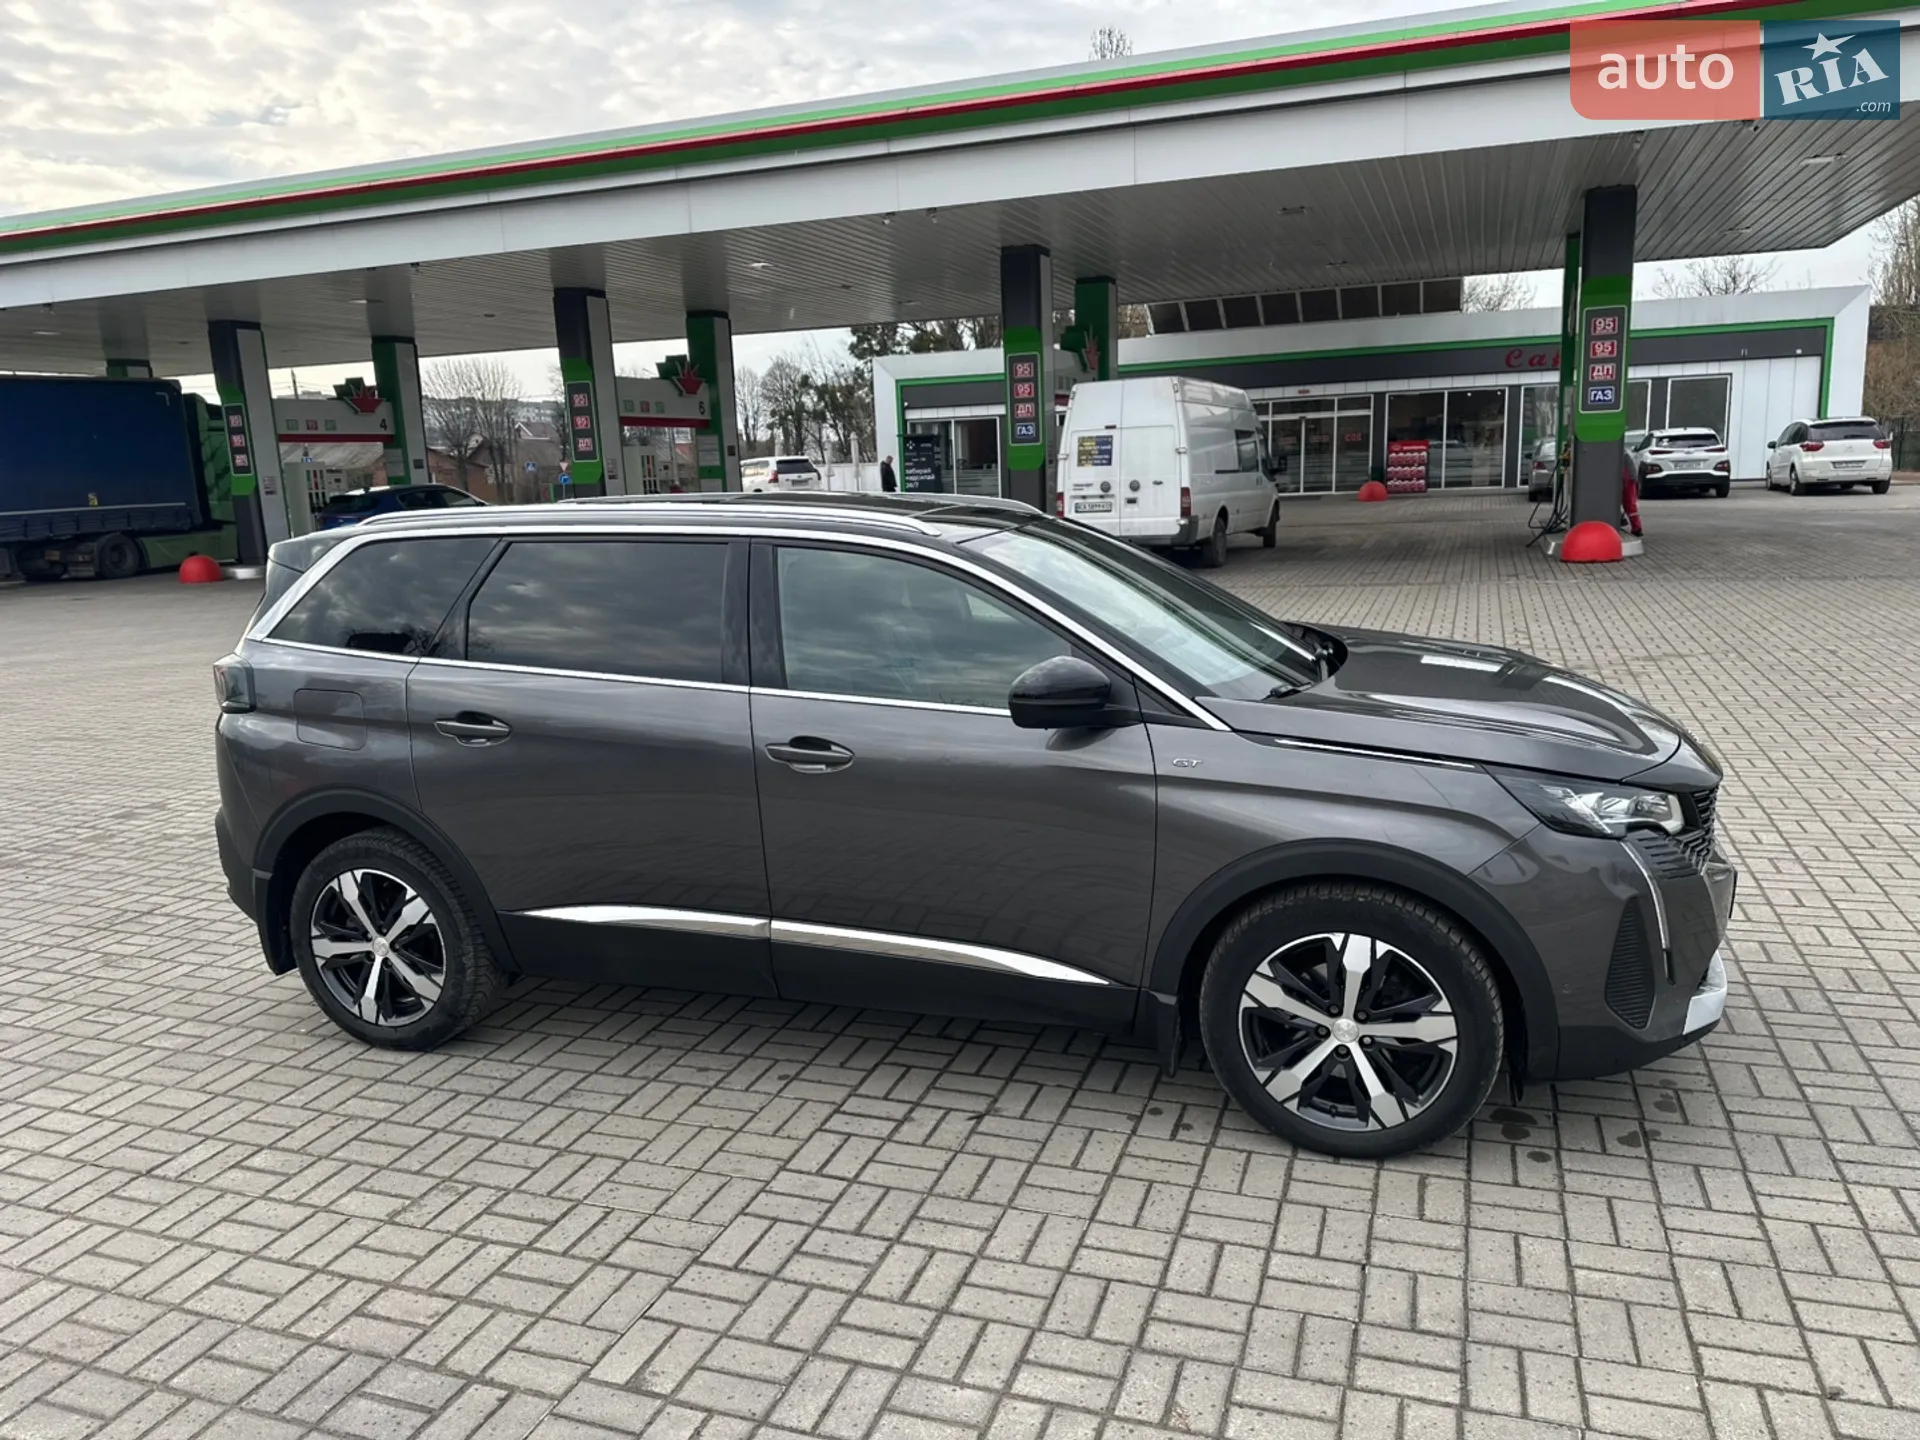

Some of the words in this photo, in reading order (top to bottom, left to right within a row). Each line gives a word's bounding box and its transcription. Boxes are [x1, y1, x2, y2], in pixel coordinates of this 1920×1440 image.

[1595, 318, 1614, 330] 95
[1594, 342, 1612, 352] 95
[1016, 364, 1030, 374] 95
[1593, 366, 1612, 376] ДП
[1017, 383, 1030, 394] 95
[1590, 389, 1612, 400] ГАЗ
[699, 402, 706, 415] 6
[379, 418, 388, 430] 4
[1017, 425, 1034, 435] ГАЗ
[1172, 758, 1203, 768] GT
